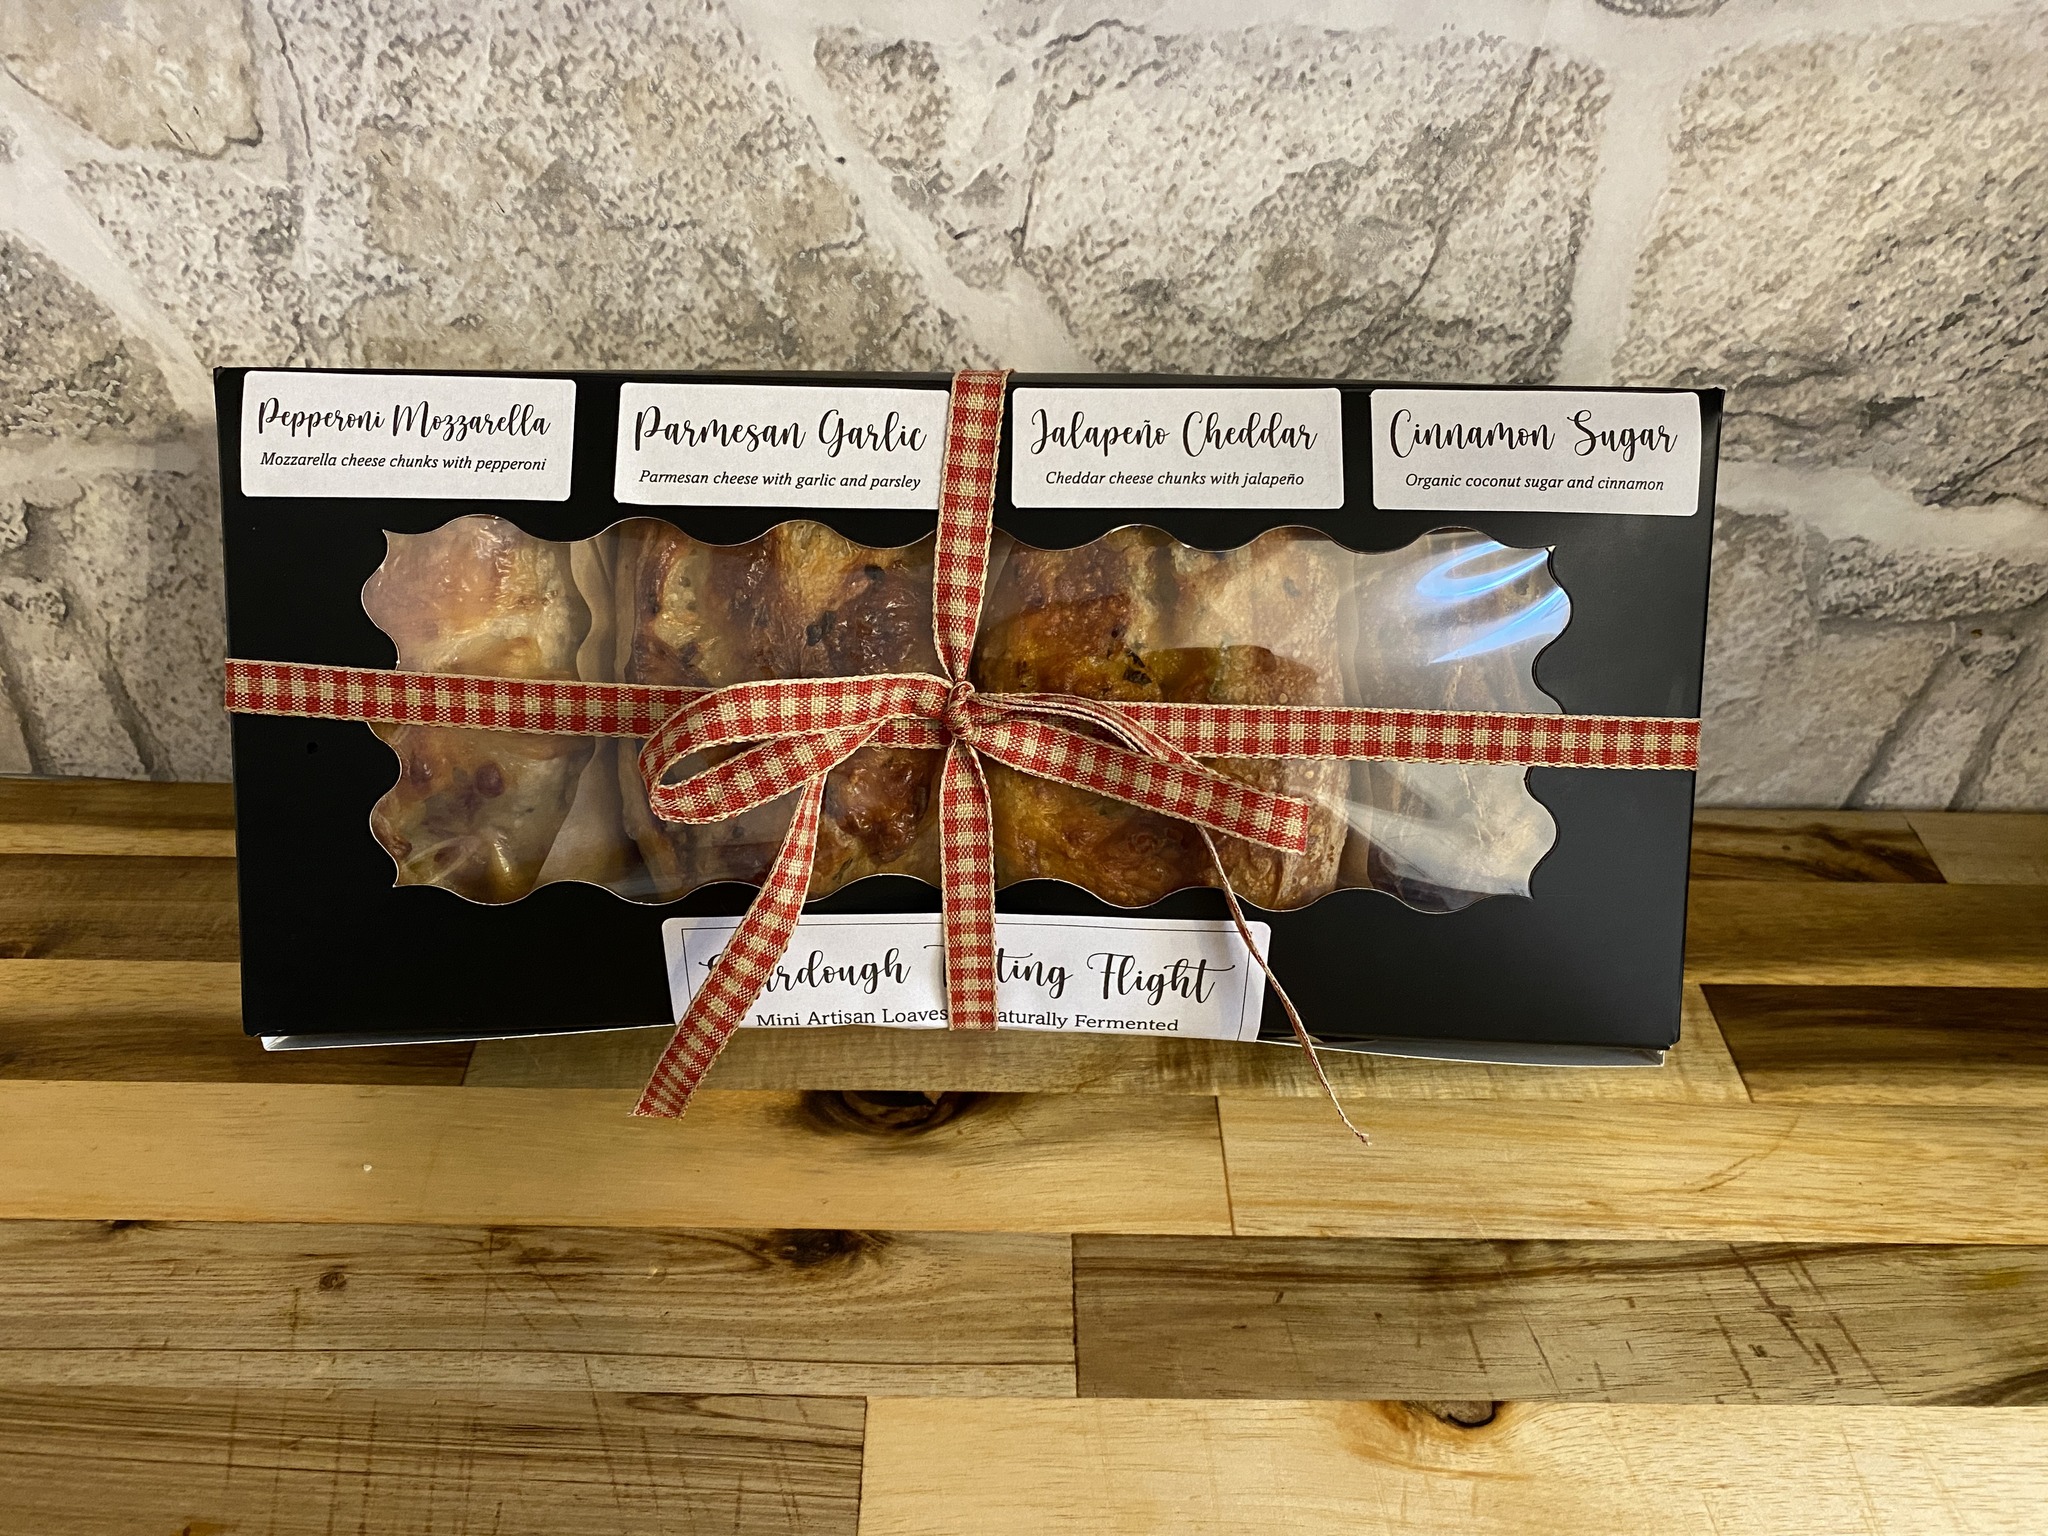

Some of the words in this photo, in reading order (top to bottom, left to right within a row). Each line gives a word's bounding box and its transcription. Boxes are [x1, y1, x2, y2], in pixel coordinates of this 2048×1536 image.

[259, 398, 385, 437] Pepperoni
[393, 401, 551, 441] Mozzarella
[635, 406, 806, 452] Parmesan
[819, 410, 927, 457] Garlic
[1031, 409, 1170, 456] Jalapeño
[1183, 411, 1317, 457] Cheddar
[1391, 409, 1555, 458] Cinnamon
[1567, 410, 1677, 462] Sugar
[260, 452, 336, 466] Mozzarella
[342, 453, 385, 466] cheese
[390, 454, 438, 468] chunks
[443, 456, 471, 468] with
[475, 459, 546, 472] pepperoni
[639, 470, 708, 483] Parmesan
[714, 472, 758, 484] cheese
[763, 473, 791, 485] with
[795, 474, 836, 489] garlic
[840, 475, 867, 486] and
[870, 475, 920, 491] parsley
[1046, 472, 1105, 484] Cheddar
[1109, 472, 1153, 484] cheese
[1158, 472, 1206, 484] chunks
[1211, 472, 1239, 485] with
[1241, 472, 1305, 488] jalapeño
[1406, 474, 1461, 489] Organic
[1466, 477, 1521, 487] coconut
[1524, 479, 1564, 491] sugar
[1567, 476, 1594, 488] and
[1598, 477, 1663, 490] cinnamon
[699, 947, 912, 995] rdough
[923, 945, 1074, 1000] ting
[1087, 953, 1235, 1005] Flight
[756, 1013, 800, 1026] Mini
[807, 1009, 876, 1025] Artisan
[882, 1006, 947, 1022] Loaves
[998, 1011, 1068, 1030] aturally
[1075, 1015, 1178, 1031] Fermented
